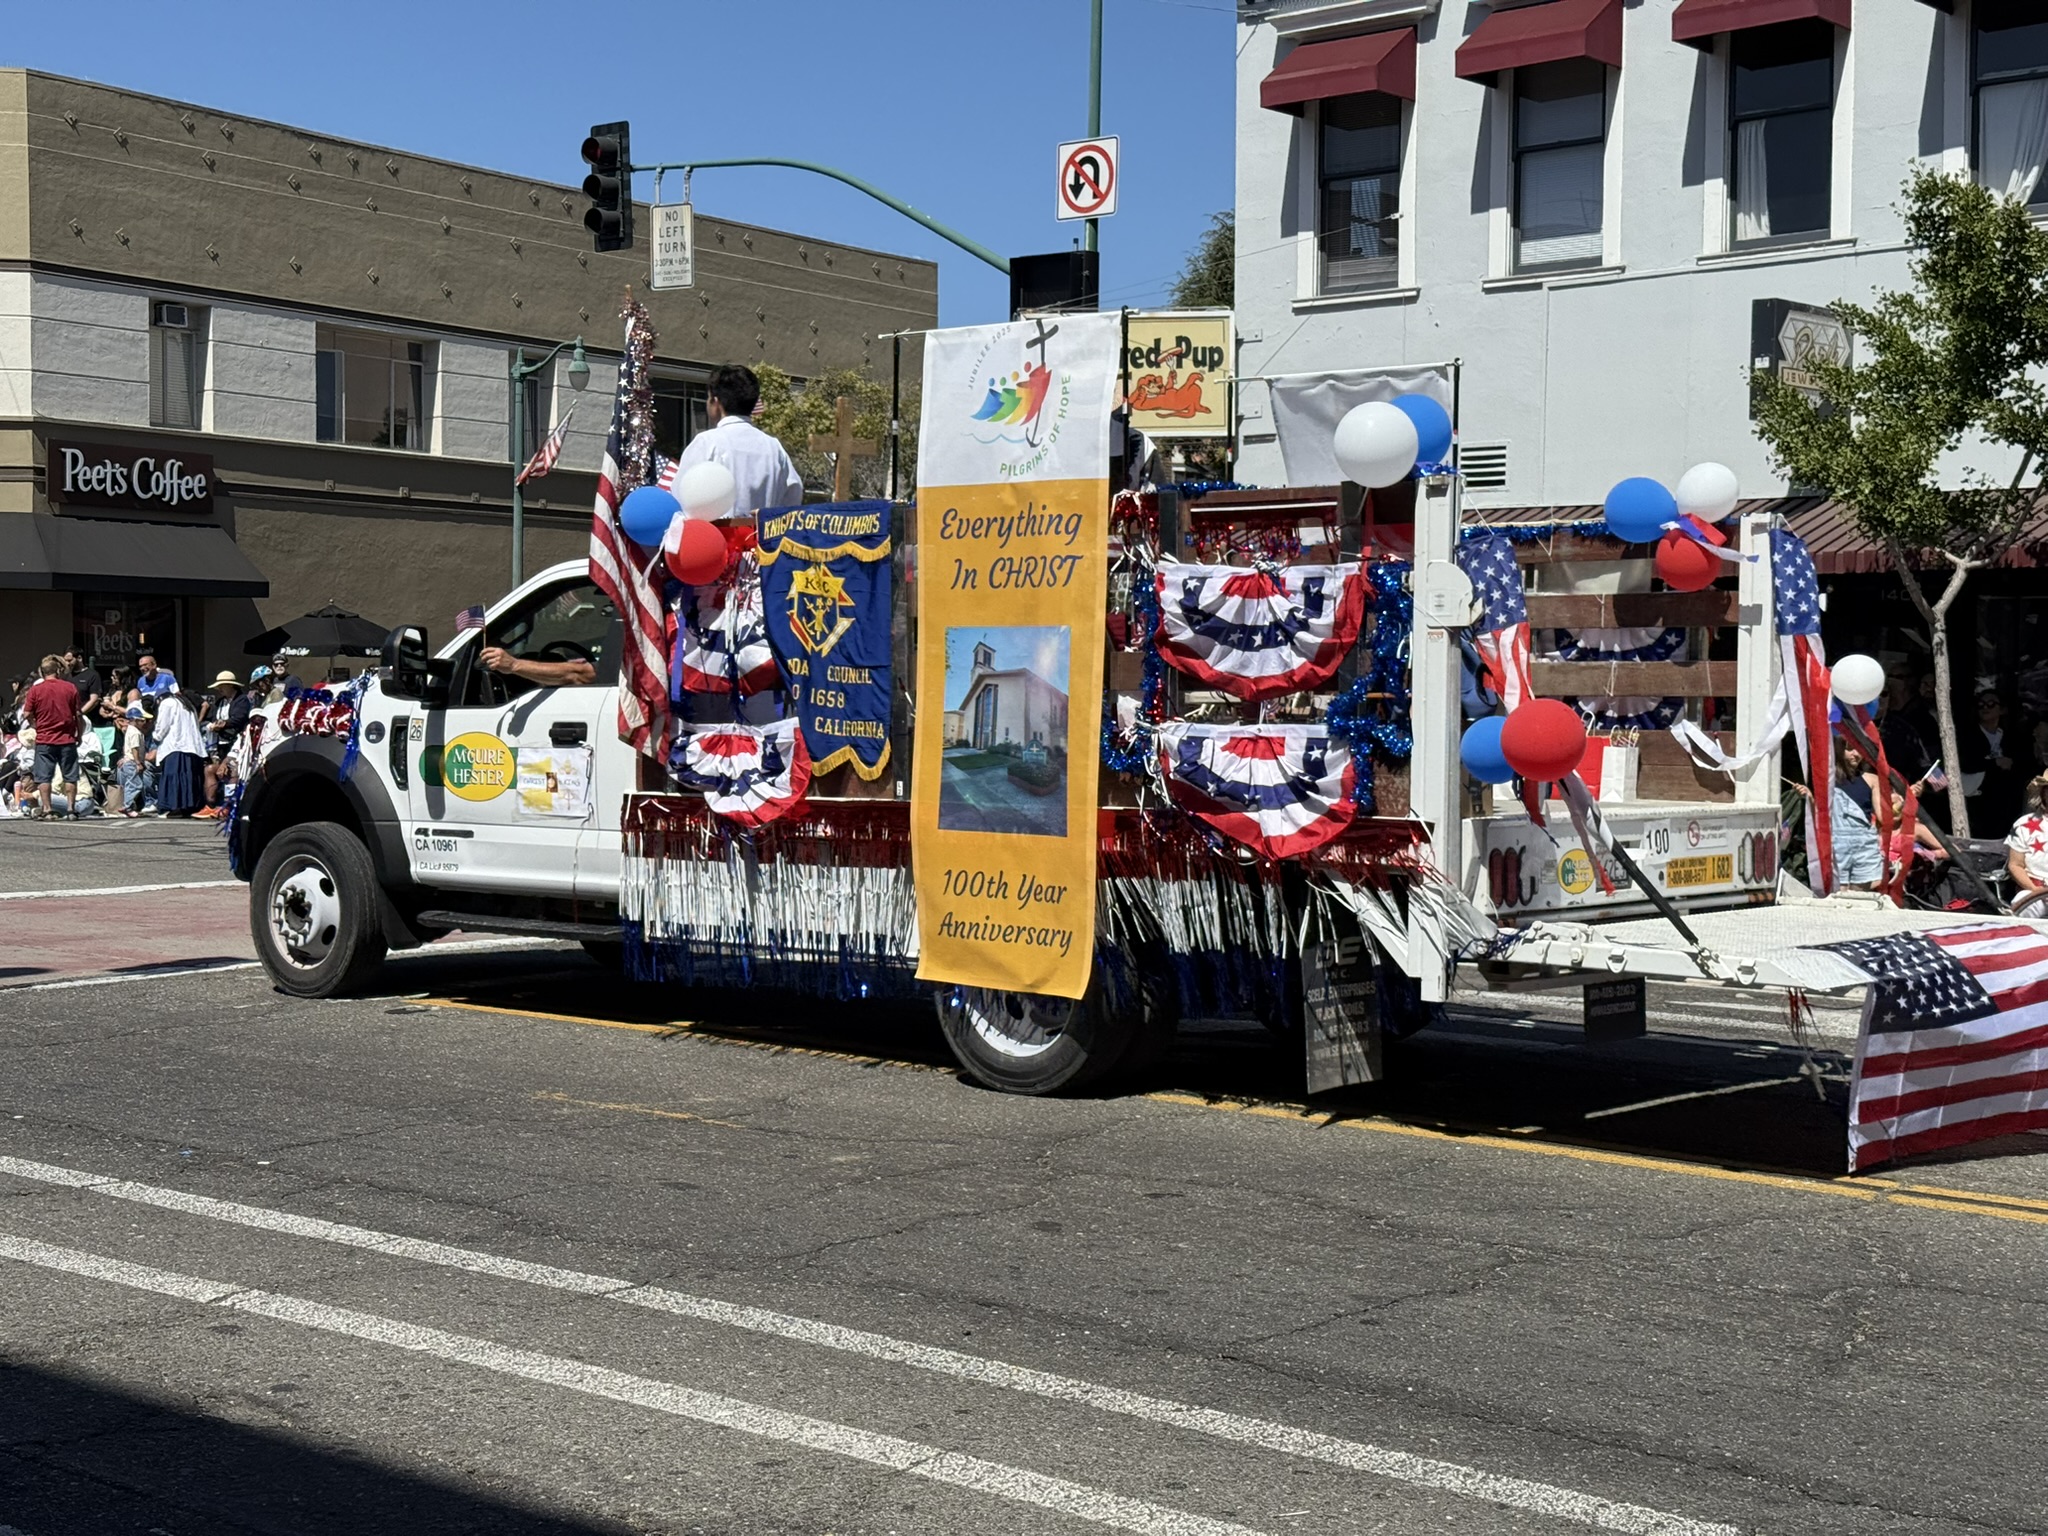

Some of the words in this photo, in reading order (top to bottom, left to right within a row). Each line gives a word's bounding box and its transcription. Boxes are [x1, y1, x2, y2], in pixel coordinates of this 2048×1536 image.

[666, 211, 678, 221] NO
[659, 226, 685, 238] LEFT
[658, 242, 686, 253] TURN
[969, 344, 990, 390] JUBILEE
[992, 325, 1012, 344] 2025
[1175, 335, 1224, 373] Pup
[1000, 445, 1049, 477] PILGRIMS
[1049, 423, 1061, 443] OF
[1057, 375, 1071, 419] HOPE
[60, 448, 128, 497] Peet's
[132, 457, 207, 506] Coffee
[805, 513, 822, 530] OF
[821, 513, 881, 536] COLUMBUS
[939, 502, 1083, 549] Everything
[950, 558, 977, 590] In
[989, 555, 1084, 590] CHRIST
[827, 665, 872, 684] COUNCIL
[810, 688, 845, 709] 1658
[411, 725, 422, 739] 26
[815, 716, 885, 739] CALIFORNIA
[453, 768, 505, 786] HESTER
[415, 839, 430, 851] CA
[432, 840, 458, 852] 10961
[942, 869, 1008, 900] 100th
[1017, 874, 1068, 910] Year
[938, 912, 1073, 958] Anniversary
